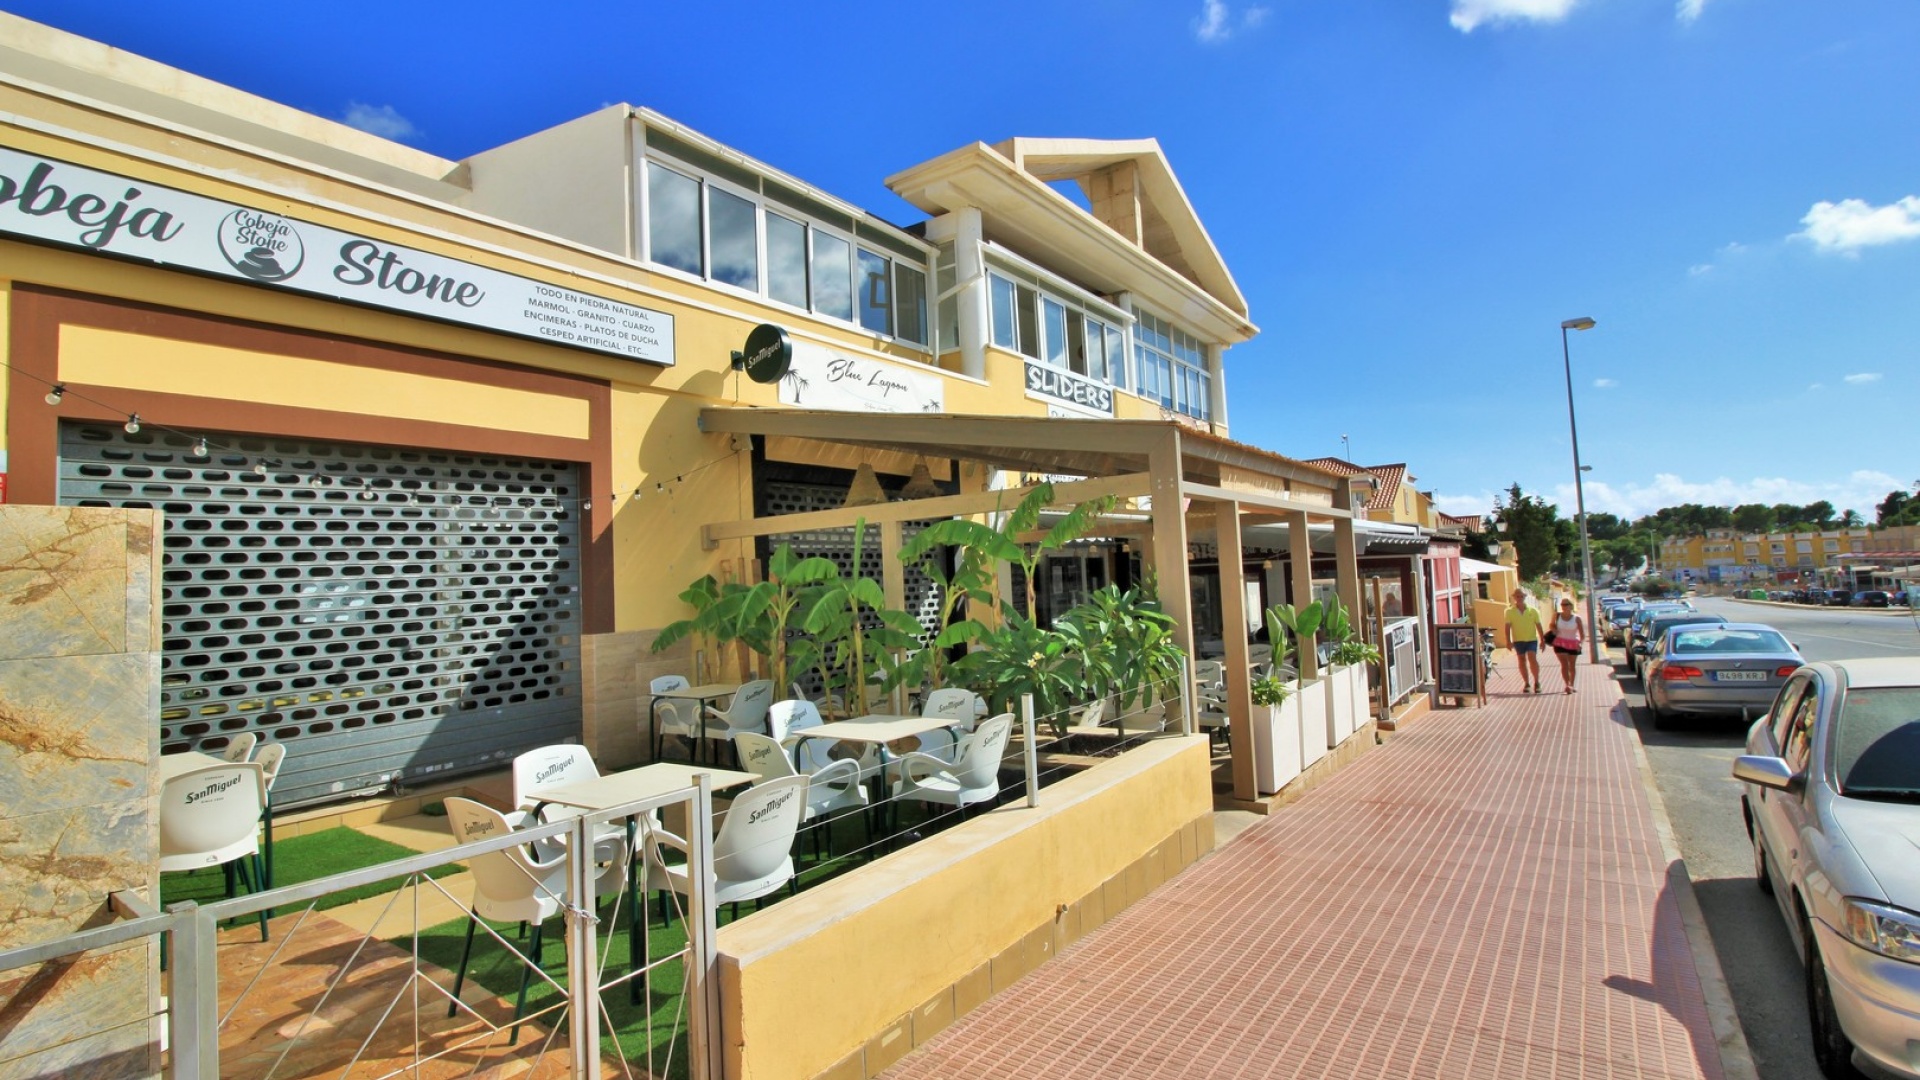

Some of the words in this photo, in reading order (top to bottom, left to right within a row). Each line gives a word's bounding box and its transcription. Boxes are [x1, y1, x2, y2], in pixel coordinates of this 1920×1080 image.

[234, 209, 290, 239] Cobeja
[236, 226, 289, 252] Stone
[333, 239, 486, 308] Stone
[528, 297, 570, 314] MARMOL
[577, 309, 616, 325] GRANITO
[622, 320, 655, 334] CUARZO
[535, 286, 562, 299] TODO
[564, 293, 577, 303] EN
[579, 297, 610, 311] PIEDRA
[612, 305, 649, 320] NATURAL
[524, 310, 577, 329] ENCIMERAS
[584, 323, 616, 337] PLATOS
[618, 331, 629, 340] DE
[631, 334, 659, 346] DUCHA
[539, 326, 574, 340] CESPED
[577, 334, 621, 350] ARTIFICIAL
[826, 359, 862, 382] Blue
[867, 370, 908, 398] Lagoon
[1028, 365, 1110, 411] SLIDERS
